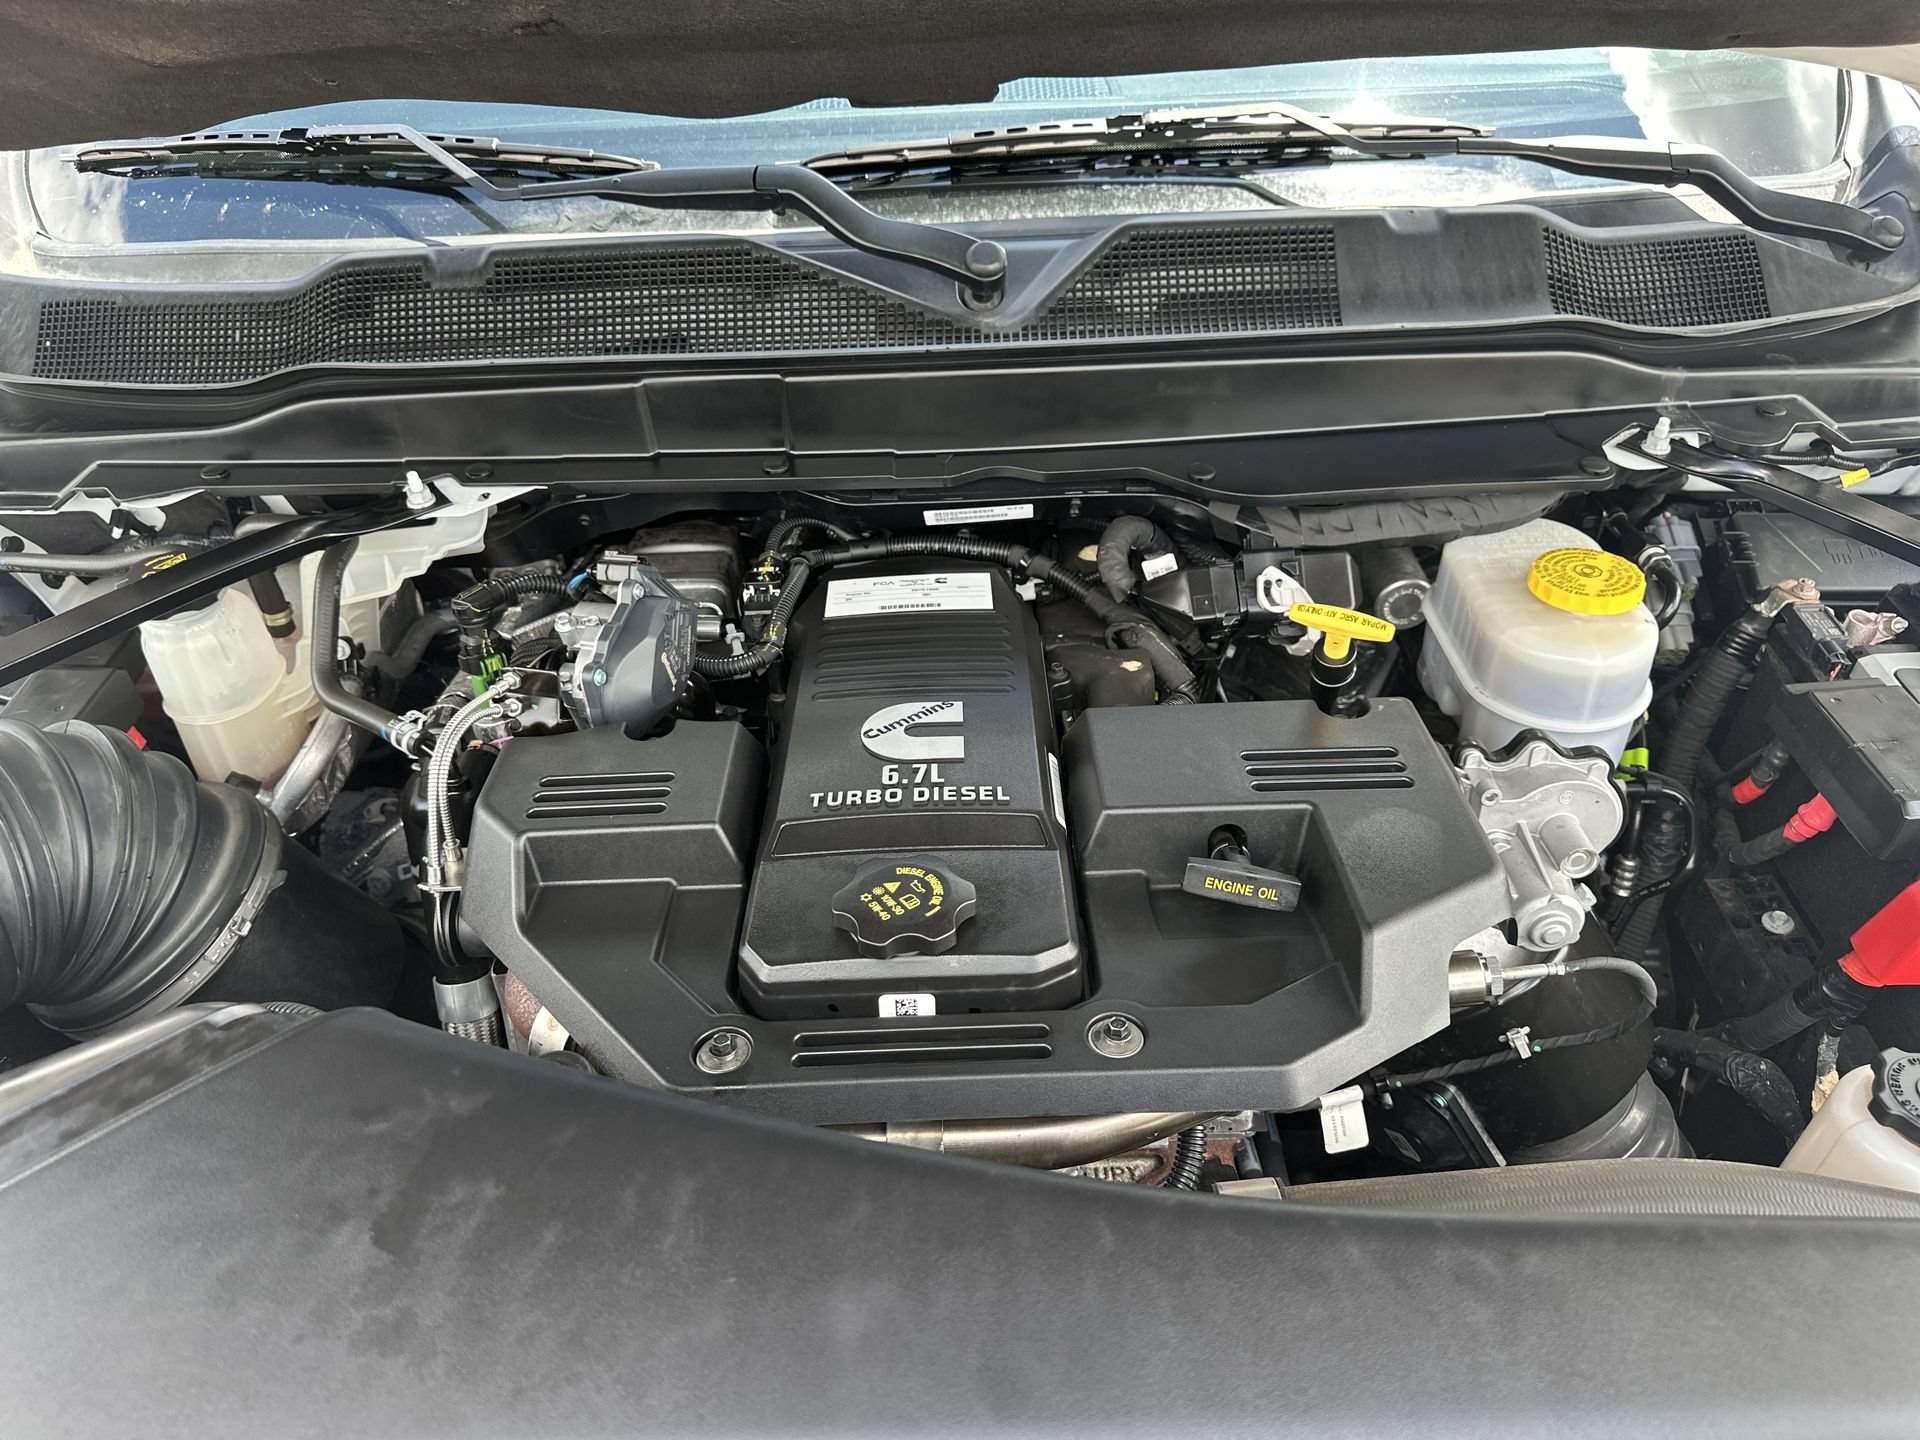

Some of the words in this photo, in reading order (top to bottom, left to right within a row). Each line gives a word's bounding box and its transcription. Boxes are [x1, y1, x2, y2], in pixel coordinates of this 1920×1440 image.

[1306, 606, 1324, 616] ONLY
[1323, 609, 1338, 618] ATF
[1339, 612, 1360, 624] ASRC
[1361, 618, 1388, 631] MOPAR
[862, 700, 955, 740] Cummins
[881, 763, 945, 786] 6.7L
[810, 787, 903, 808] TURBO
[912, 785, 1011, 803] DIESEL
[895, 867, 926, 878] DIESEL
[924, 873, 944, 896] ENGINE
[1204, 876, 1255, 897] ENGINE
[1257, 887, 1279, 901] OIL
[880, 893, 905, 916] 10W-30
[928, 895, 943, 906] OIL
[868, 901, 892, 921] 5W-40
